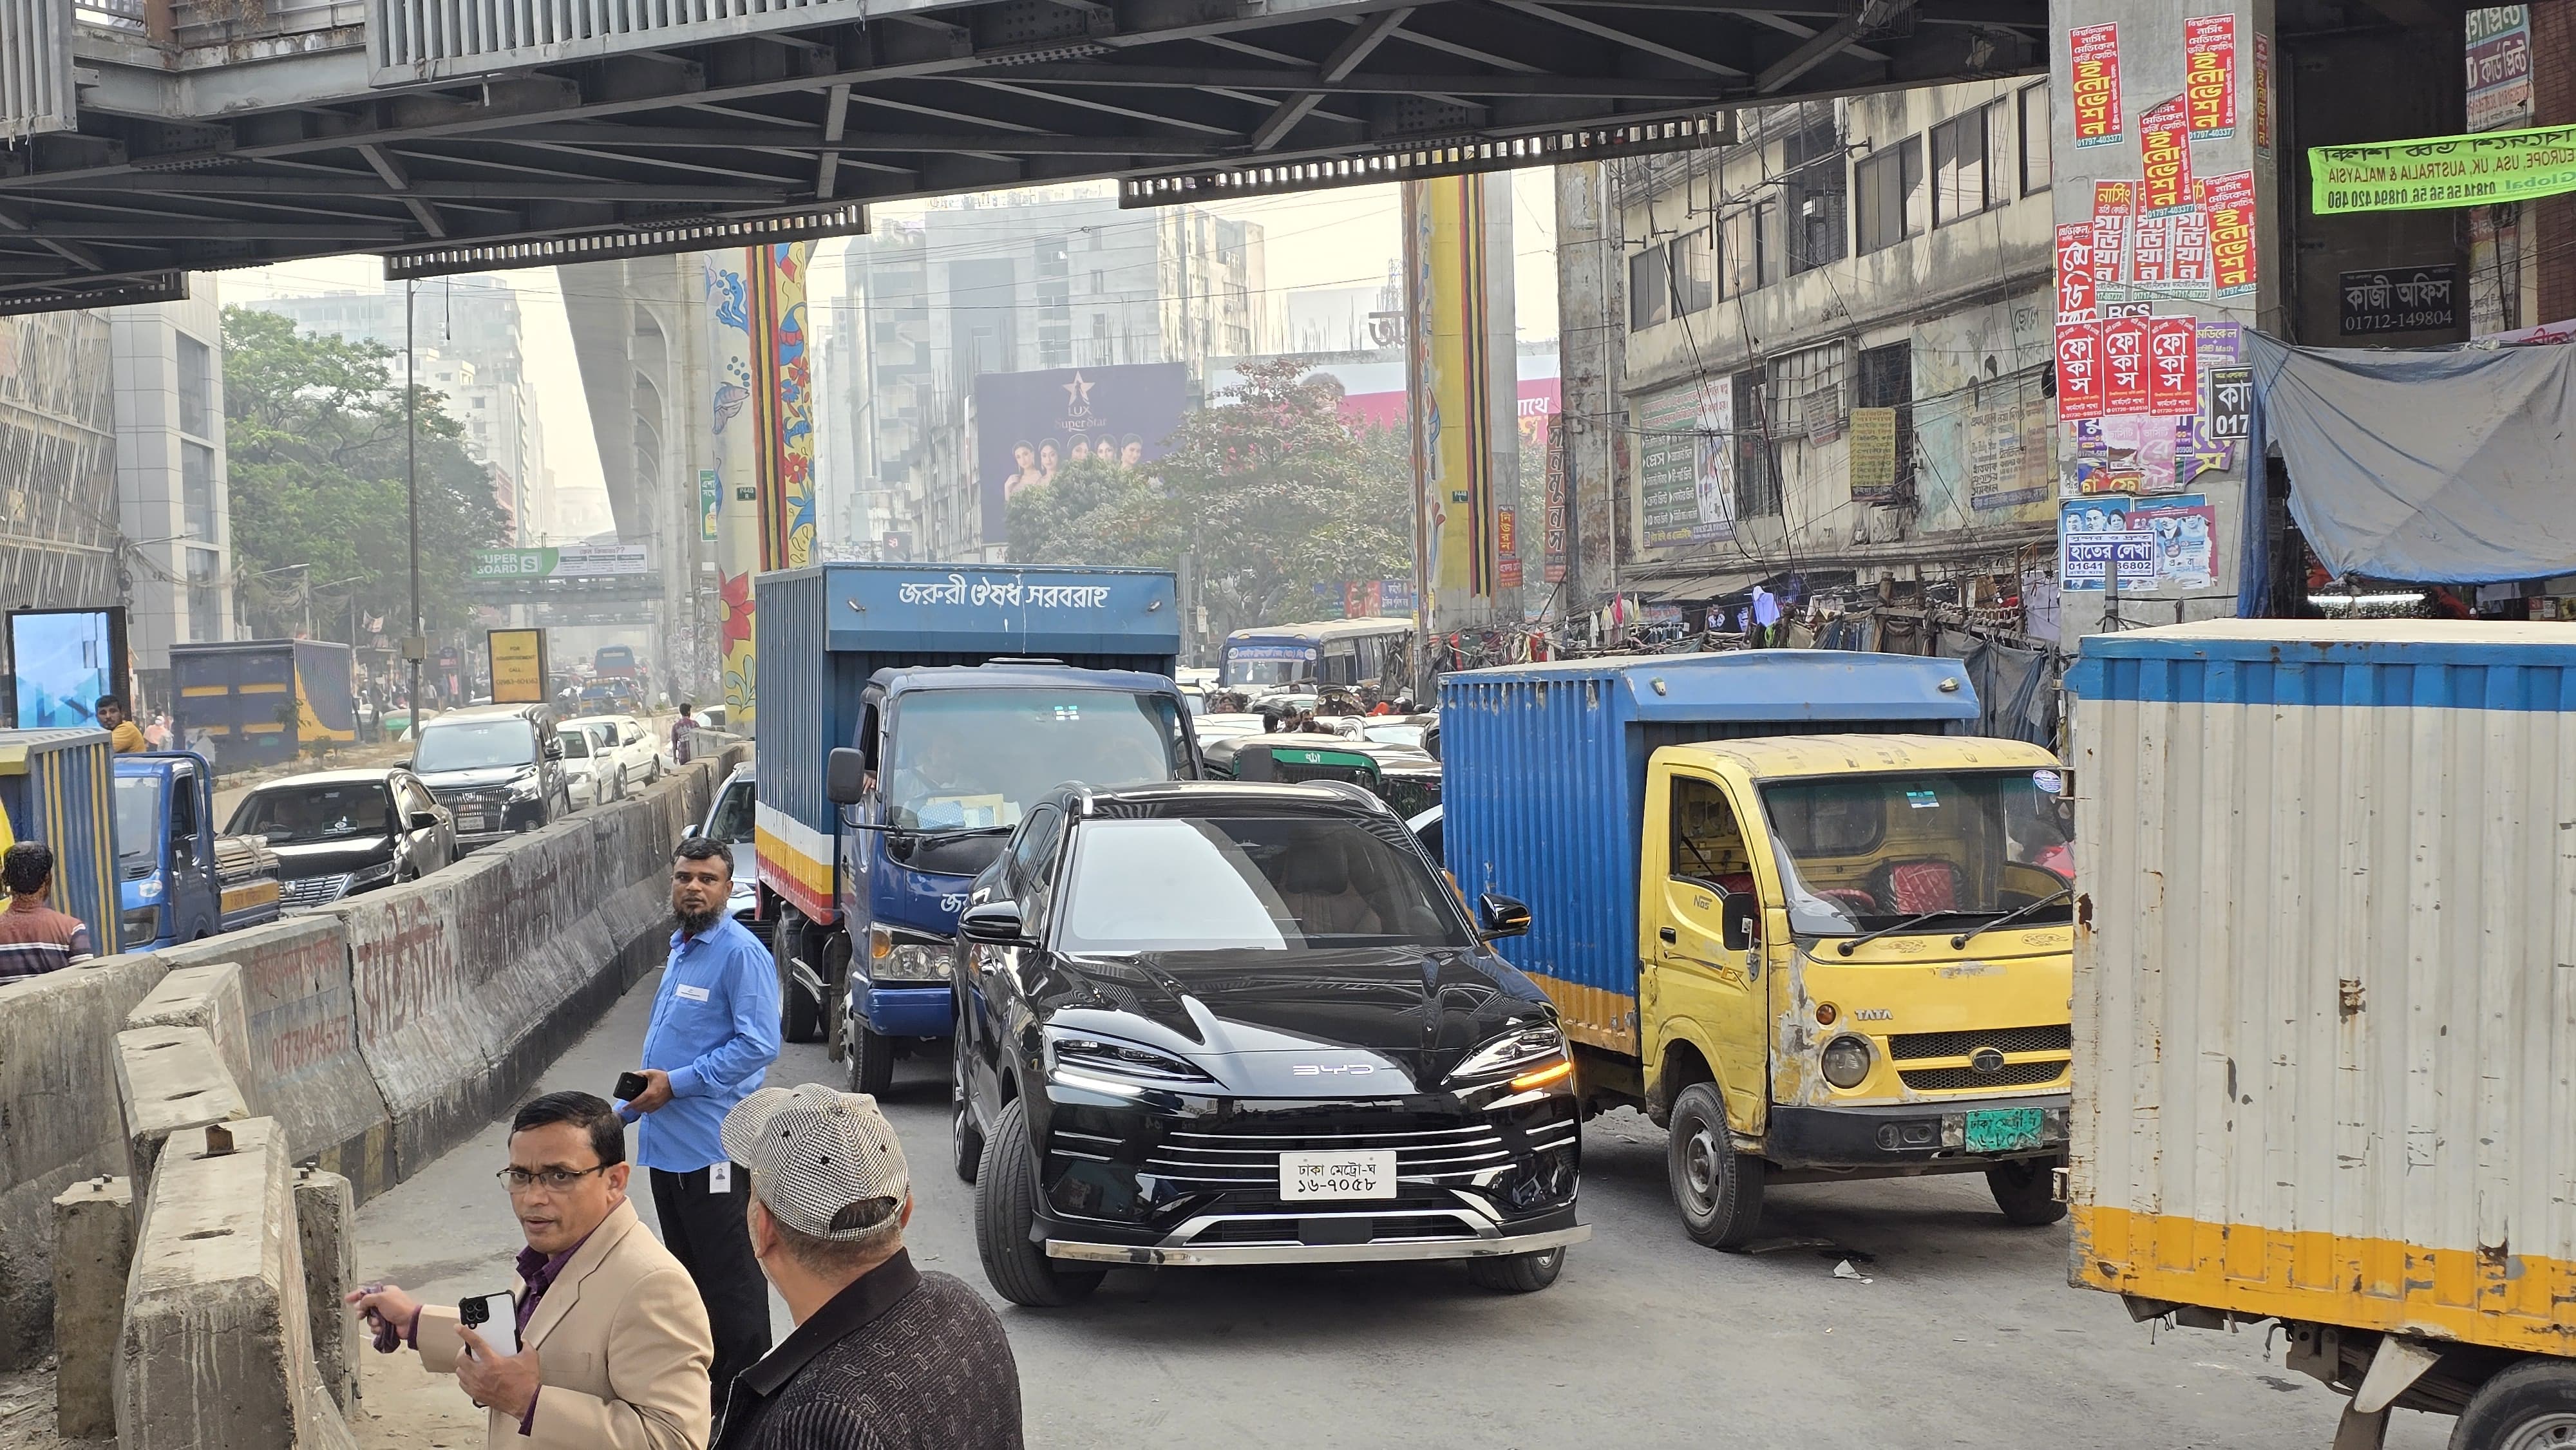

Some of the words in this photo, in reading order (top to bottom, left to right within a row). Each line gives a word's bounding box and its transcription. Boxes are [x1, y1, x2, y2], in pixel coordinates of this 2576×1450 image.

[2189, 33, 2231, 44] মেডিকেল
[2074, 42, 2115, 53] মেডিকেল
[2480, 42, 2502, 82] কার্ড
[2503, 40, 2526, 78] প্রিন্ট
[2143, 111, 2184, 125] মেডিকেল
[2098, 183, 2130, 205] নার্সিং
[2209, 189, 2251, 203] মেডিকেল
[2148, 204, 2193, 218] 01797-403377
[2345, 275, 2394, 312] কাজী
[2396, 273, 2452, 307] অফিস
[2345, 310, 2452, 330] 01712-149804
[1068, 406, 1092, 417] LUX
[1646, 452, 1665, 468] প্রেস
[2070, 543, 2113, 561] হাতের
[2117, 542, 2152, 560] লেখা
[900, 574, 967, 605] জরুরী
[971, 576, 1023, 607] ঔষধ
[1025, 585, 1110, 608] সরবরাহ
[1855, 1009, 1893, 1021] TATA
[1293, 1064, 1374, 1075] BYD
[1971, 1118, 1992, 1129] ঢাকা
[1298, 1164, 1324, 1176] ঢাকা
[1330, 1161, 1376, 1178] মেট্রো-ঘ
[1298, 1178, 1377, 1192] ১৬-৭০৫৮
